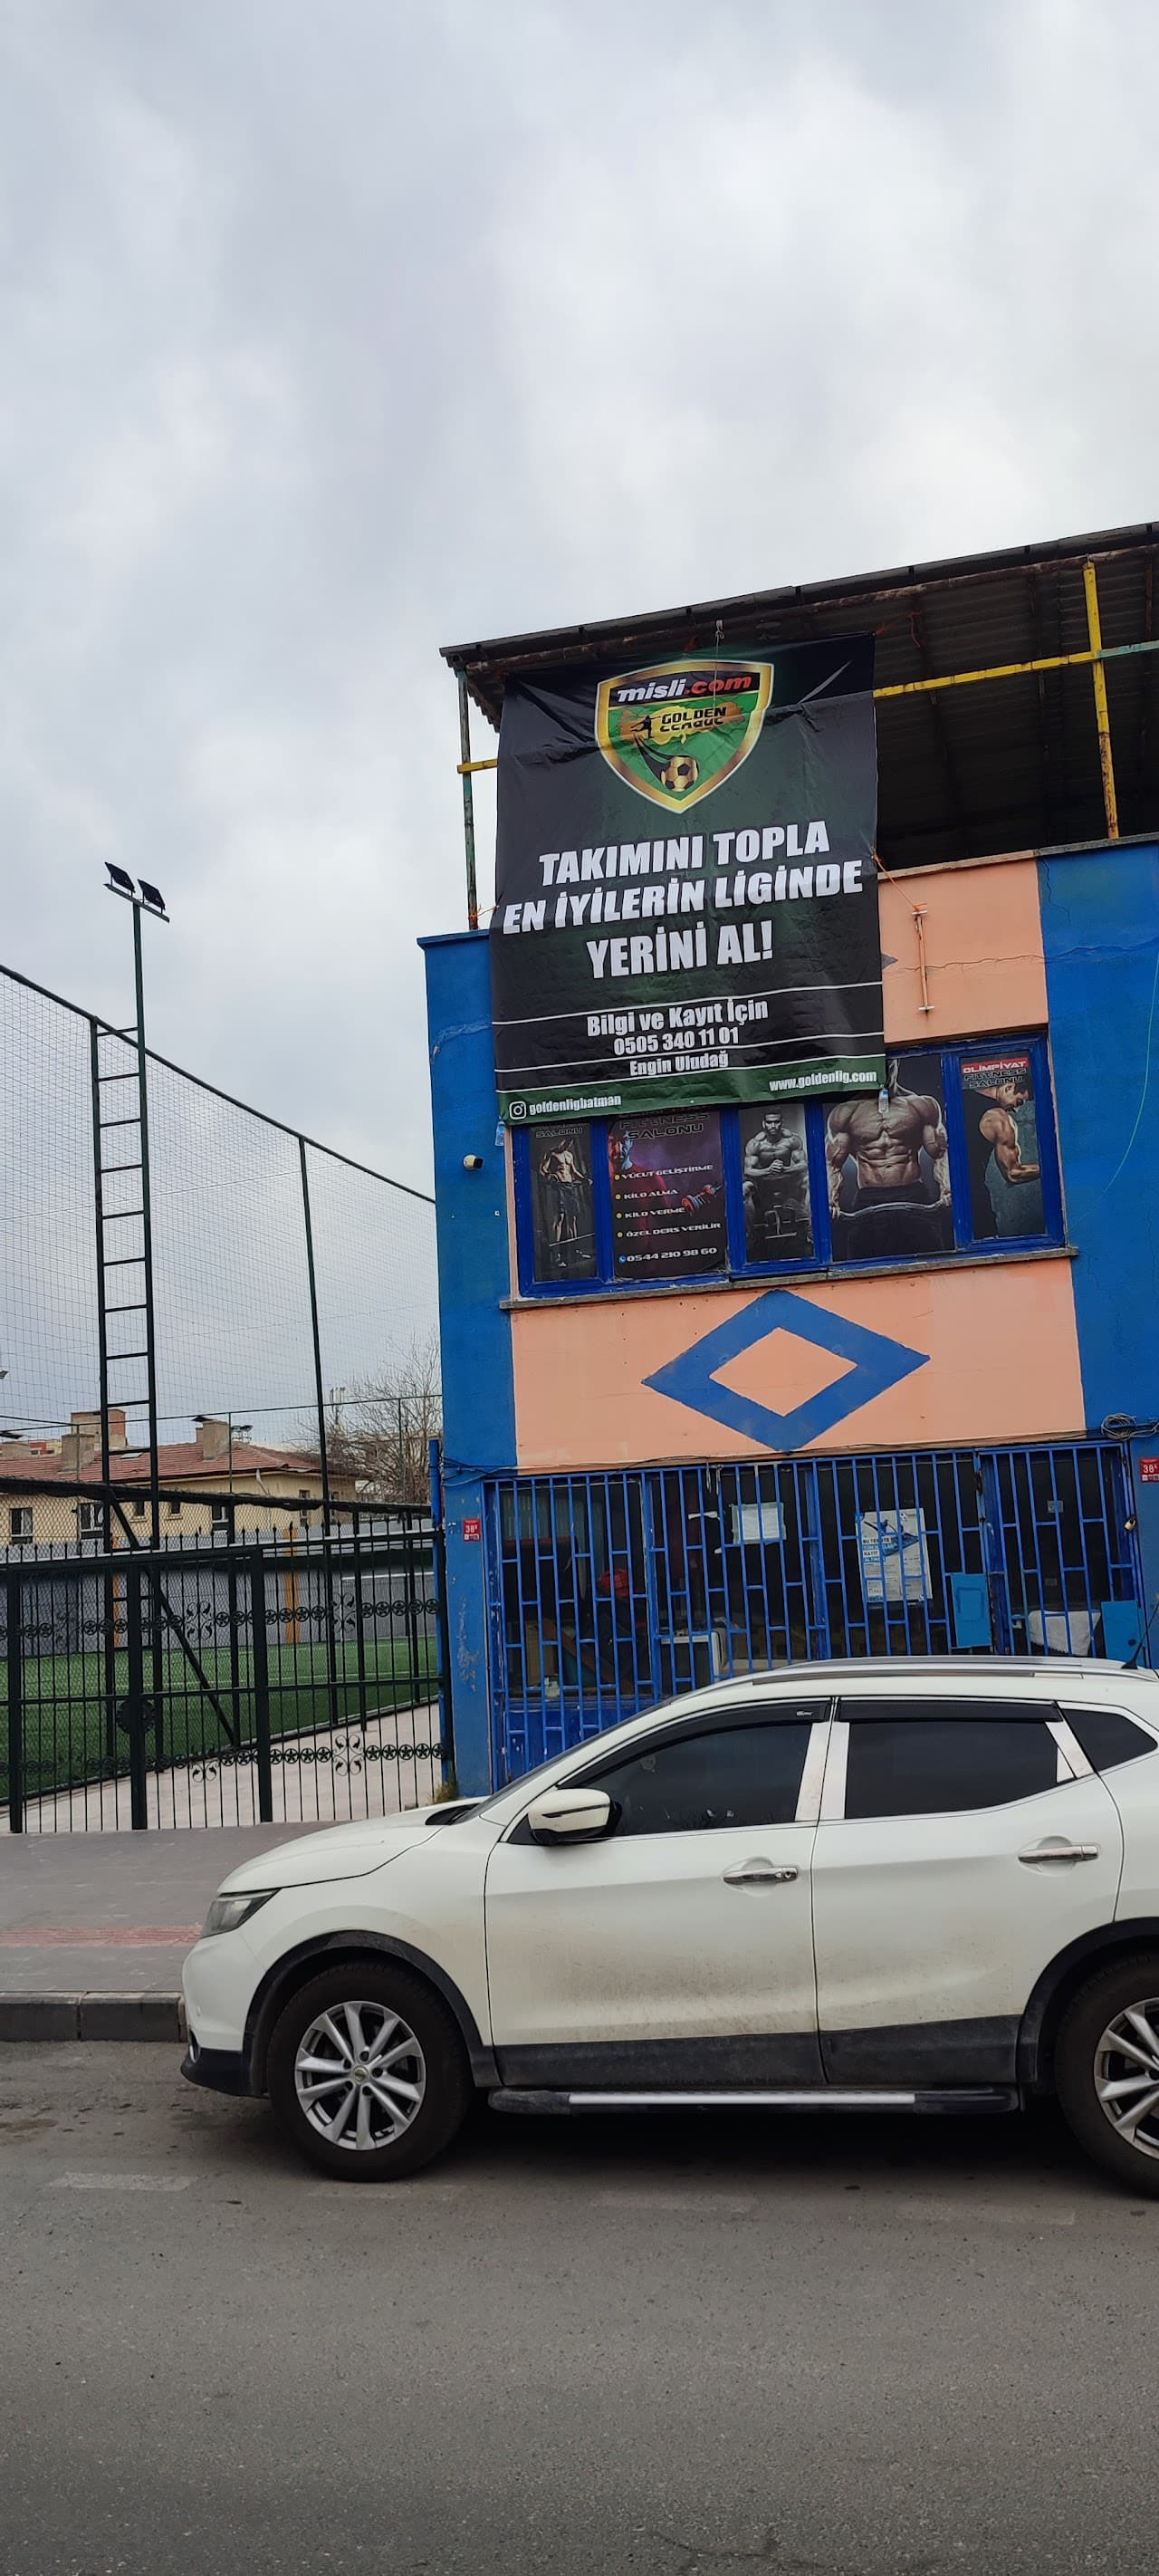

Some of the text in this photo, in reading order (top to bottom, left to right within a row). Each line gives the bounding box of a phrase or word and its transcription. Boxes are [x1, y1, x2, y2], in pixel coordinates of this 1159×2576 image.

[618, 676, 752, 702] misli.com
[662, 707, 727, 724] GOLDEN
[539, 821, 830, 887] TAKIMINI TOPLA
[503, 860, 863, 934] EN İYİLERİN LİGİNDE
[586, 919, 773, 979] YERİNİ AL!
[587, 997, 769, 1037] Bilgi ve Kayıt İçin
[614, 1026, 739, 1055] 0505 340 11 01
[629, 1050, 729, 1076] Engin Uludağ
[769, 1070, 876, 1091] www.goldenlig.com
[529, 1095, 621, 1115] goldenligbatman
[627, 1123, 704, 1139] SALONU
[648, 1189, 678, 1197] ALMA
[650, 1207, 685, 1216] VERME
[627, 1253, 659, 1262] 0544
[661, 1251, 681, 1259] 210
